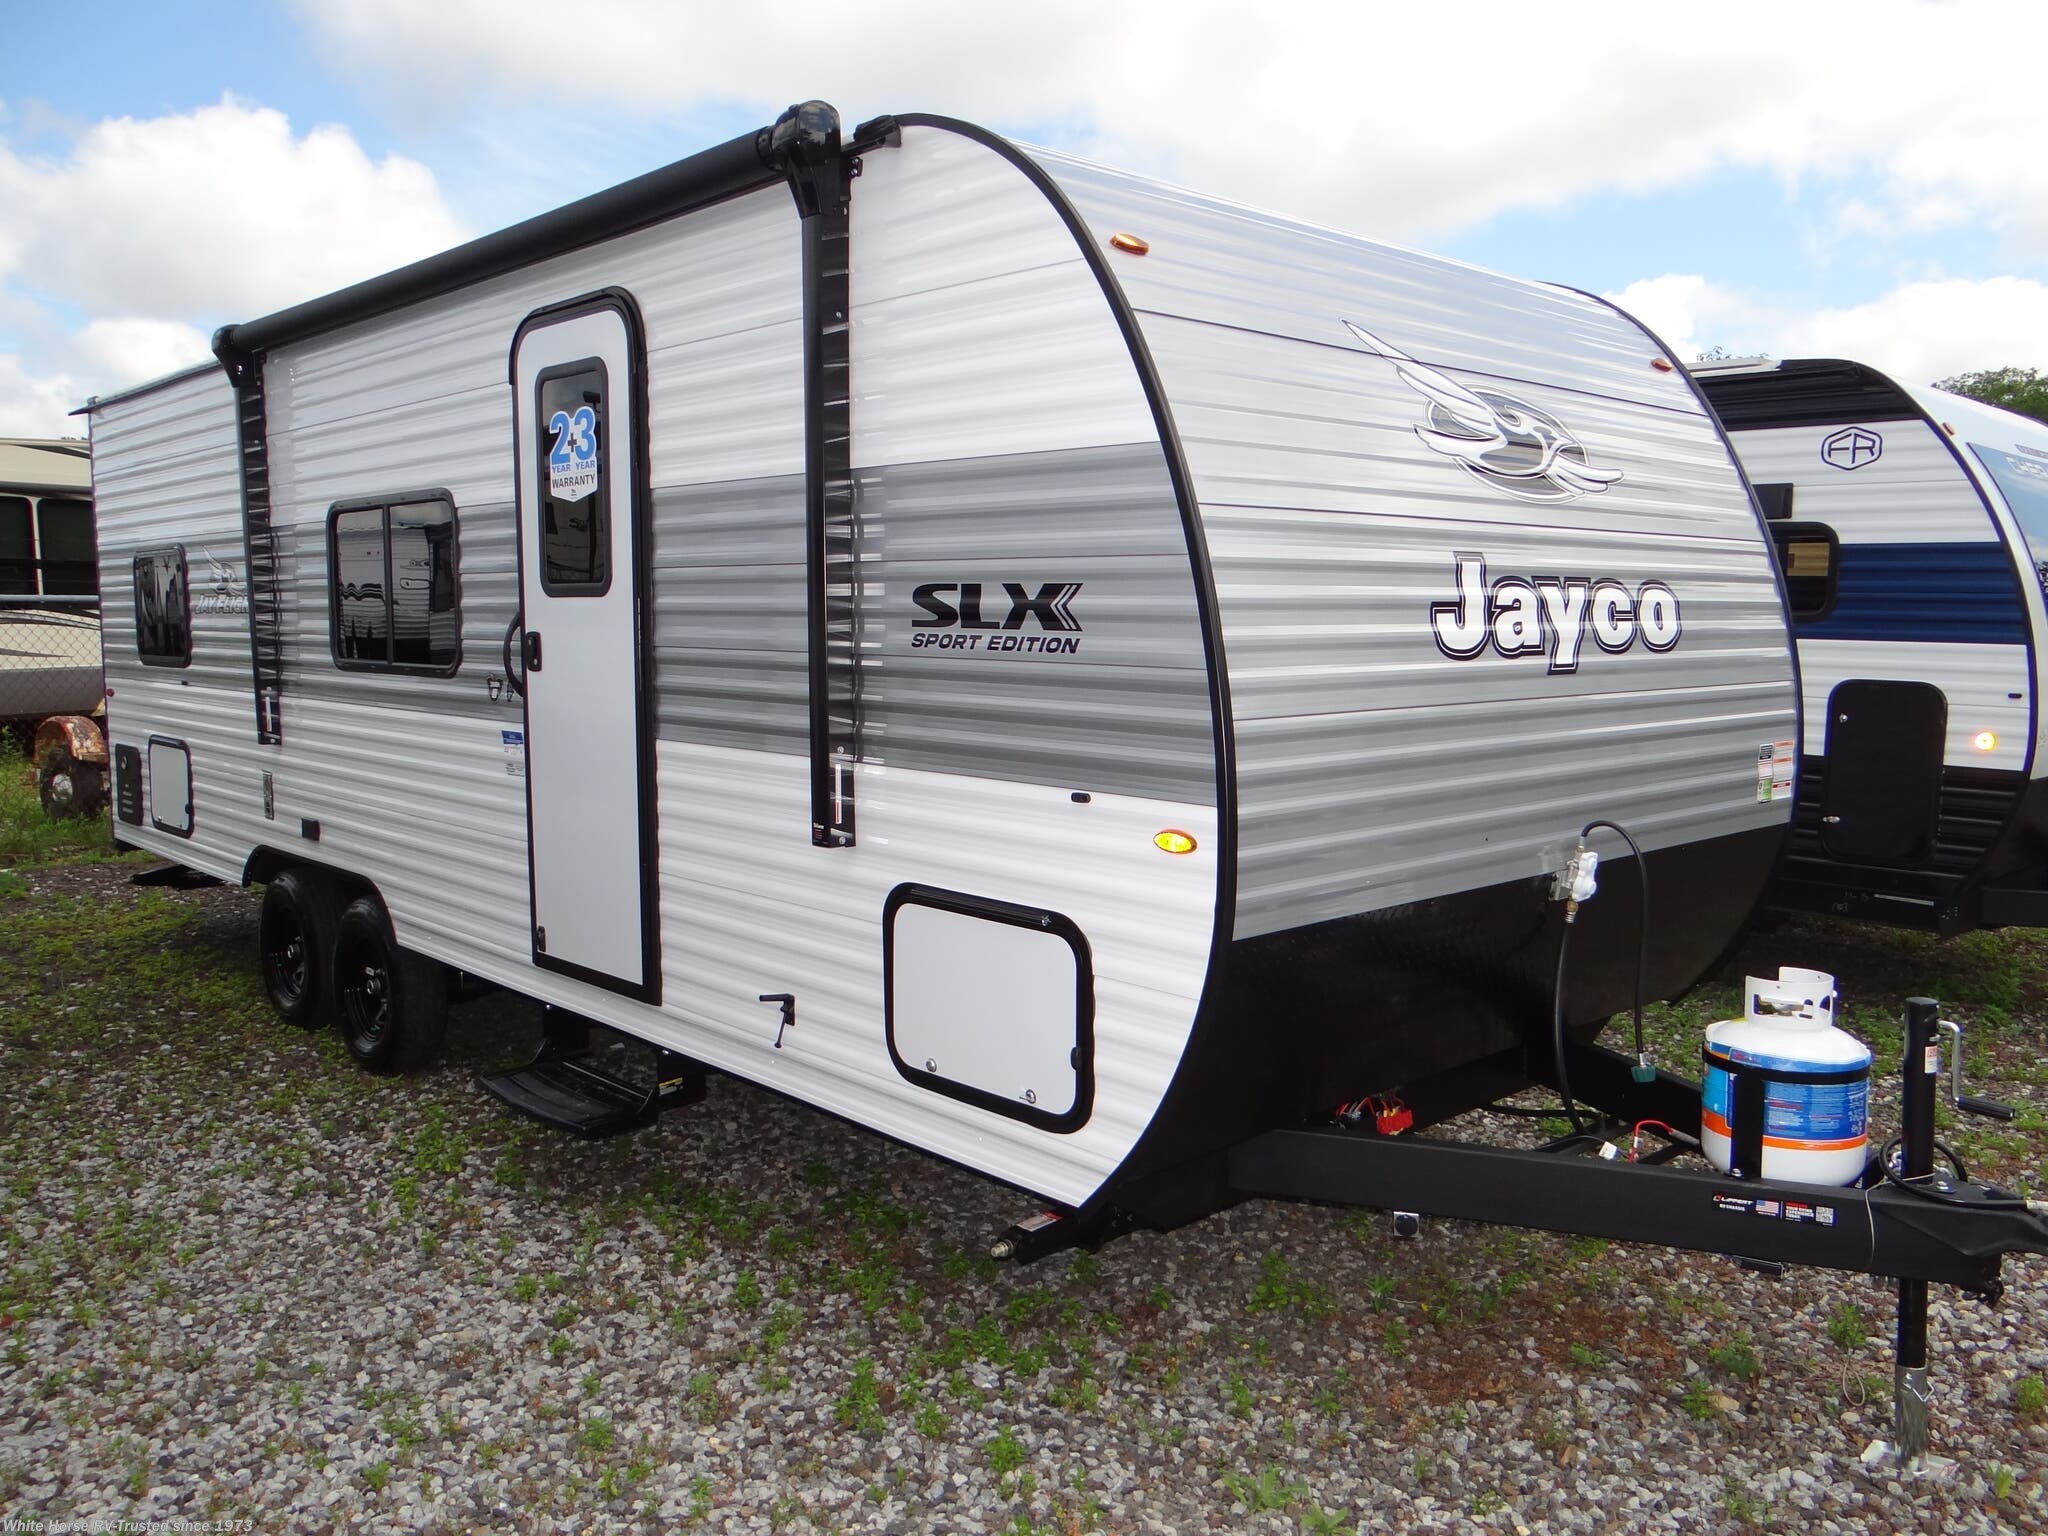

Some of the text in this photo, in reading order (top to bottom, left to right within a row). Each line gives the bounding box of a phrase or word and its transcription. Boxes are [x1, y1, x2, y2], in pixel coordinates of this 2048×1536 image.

[1827, 432, 1876, 464] FR
[552, 460, 596, 474] YEAR YEAR
[552, 475, 596, 489] WARRANTY
[195, 594, 217, 614] JAY
[911, 582, 1084, 631] SLX
[1430, 551, 1682, 675] Jayco
[911, 632, 1081, 654] SPORT EDITION
